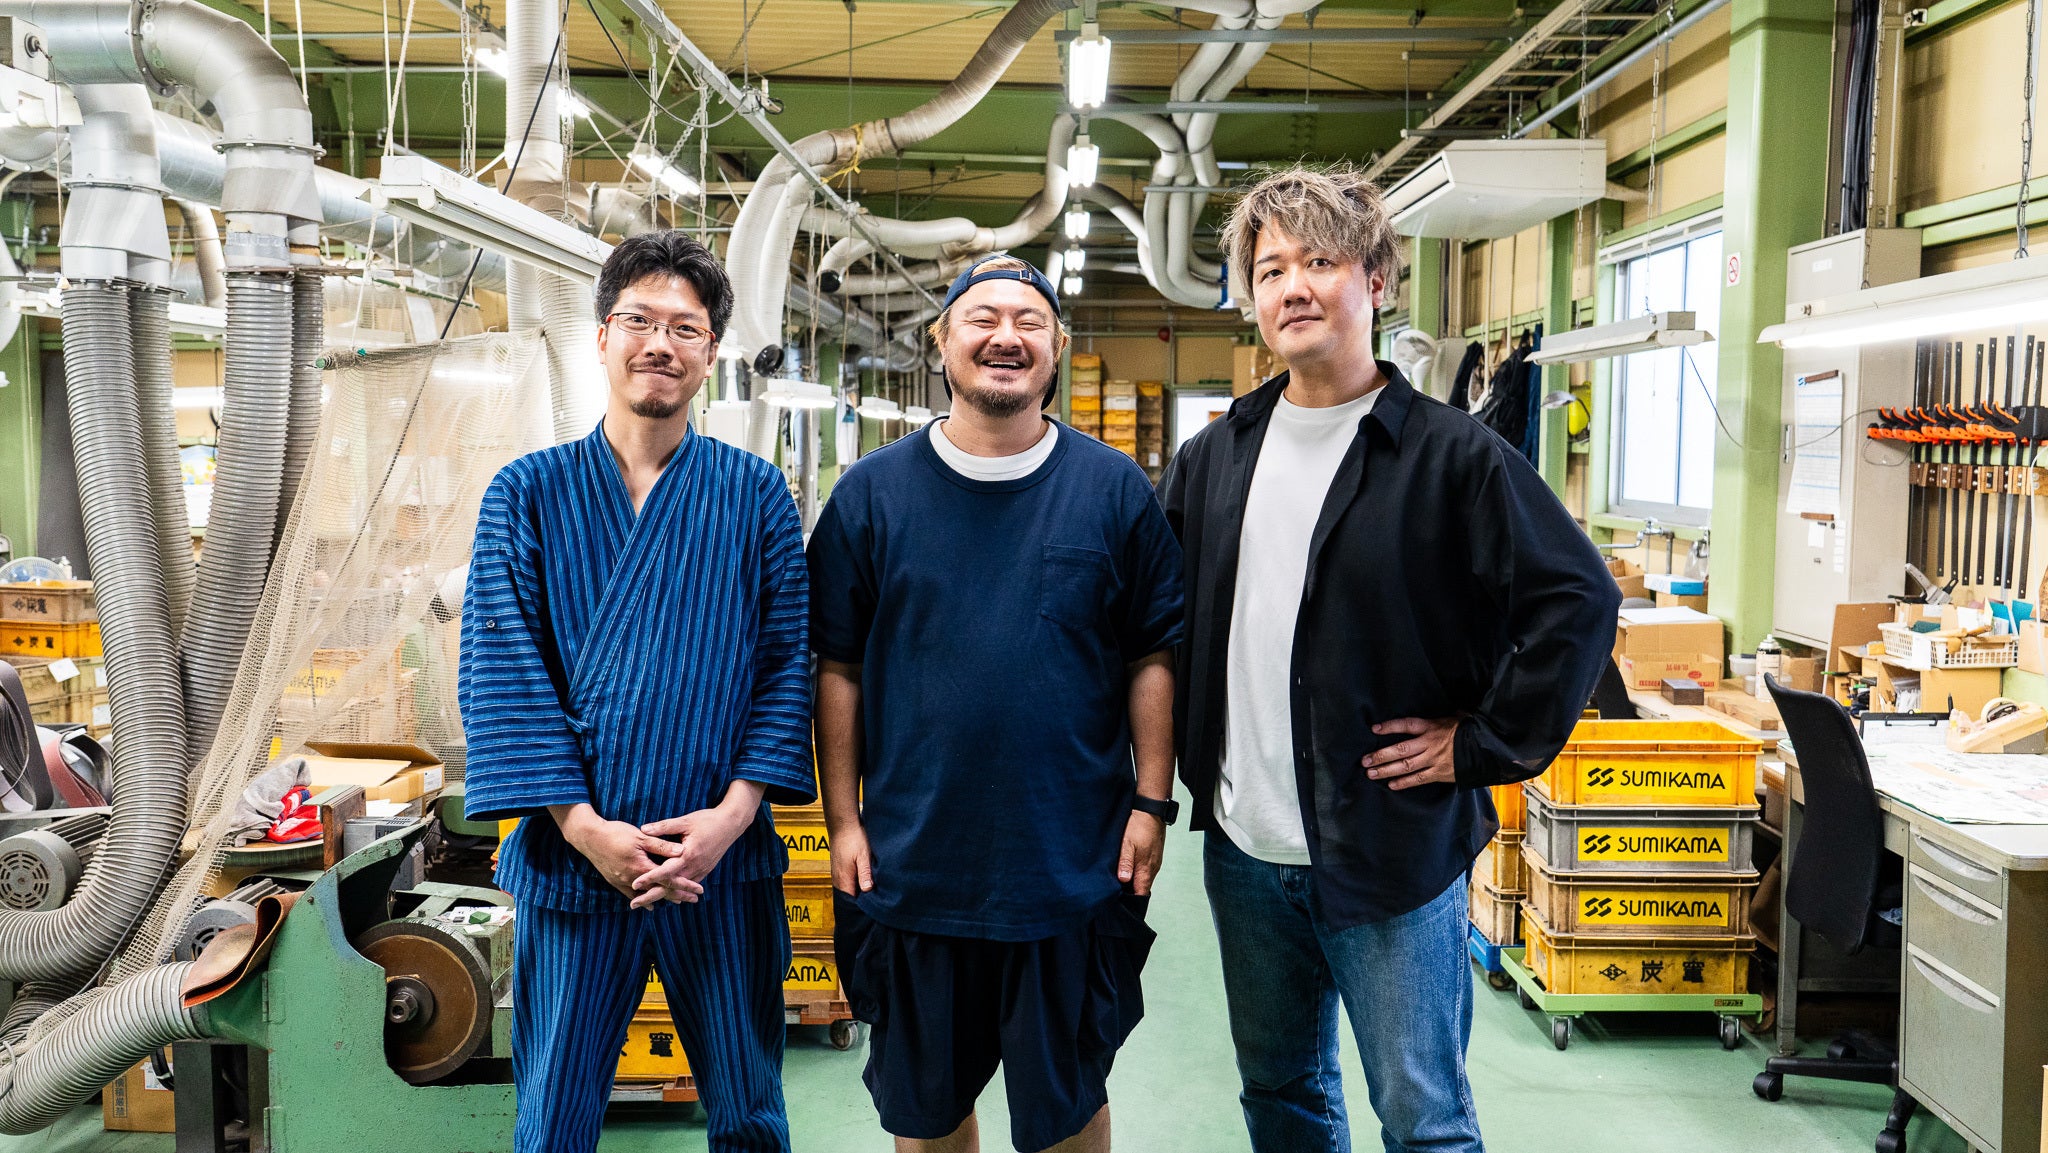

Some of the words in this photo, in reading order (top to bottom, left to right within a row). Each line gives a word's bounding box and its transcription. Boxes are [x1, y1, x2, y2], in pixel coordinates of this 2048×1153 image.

[1620, 770, 1726, 790] SUMIKAMA
[1617, 836, 1723, 854] SUMIKAMA
[1618, 899, 1723, 918] SUMIKAMA
